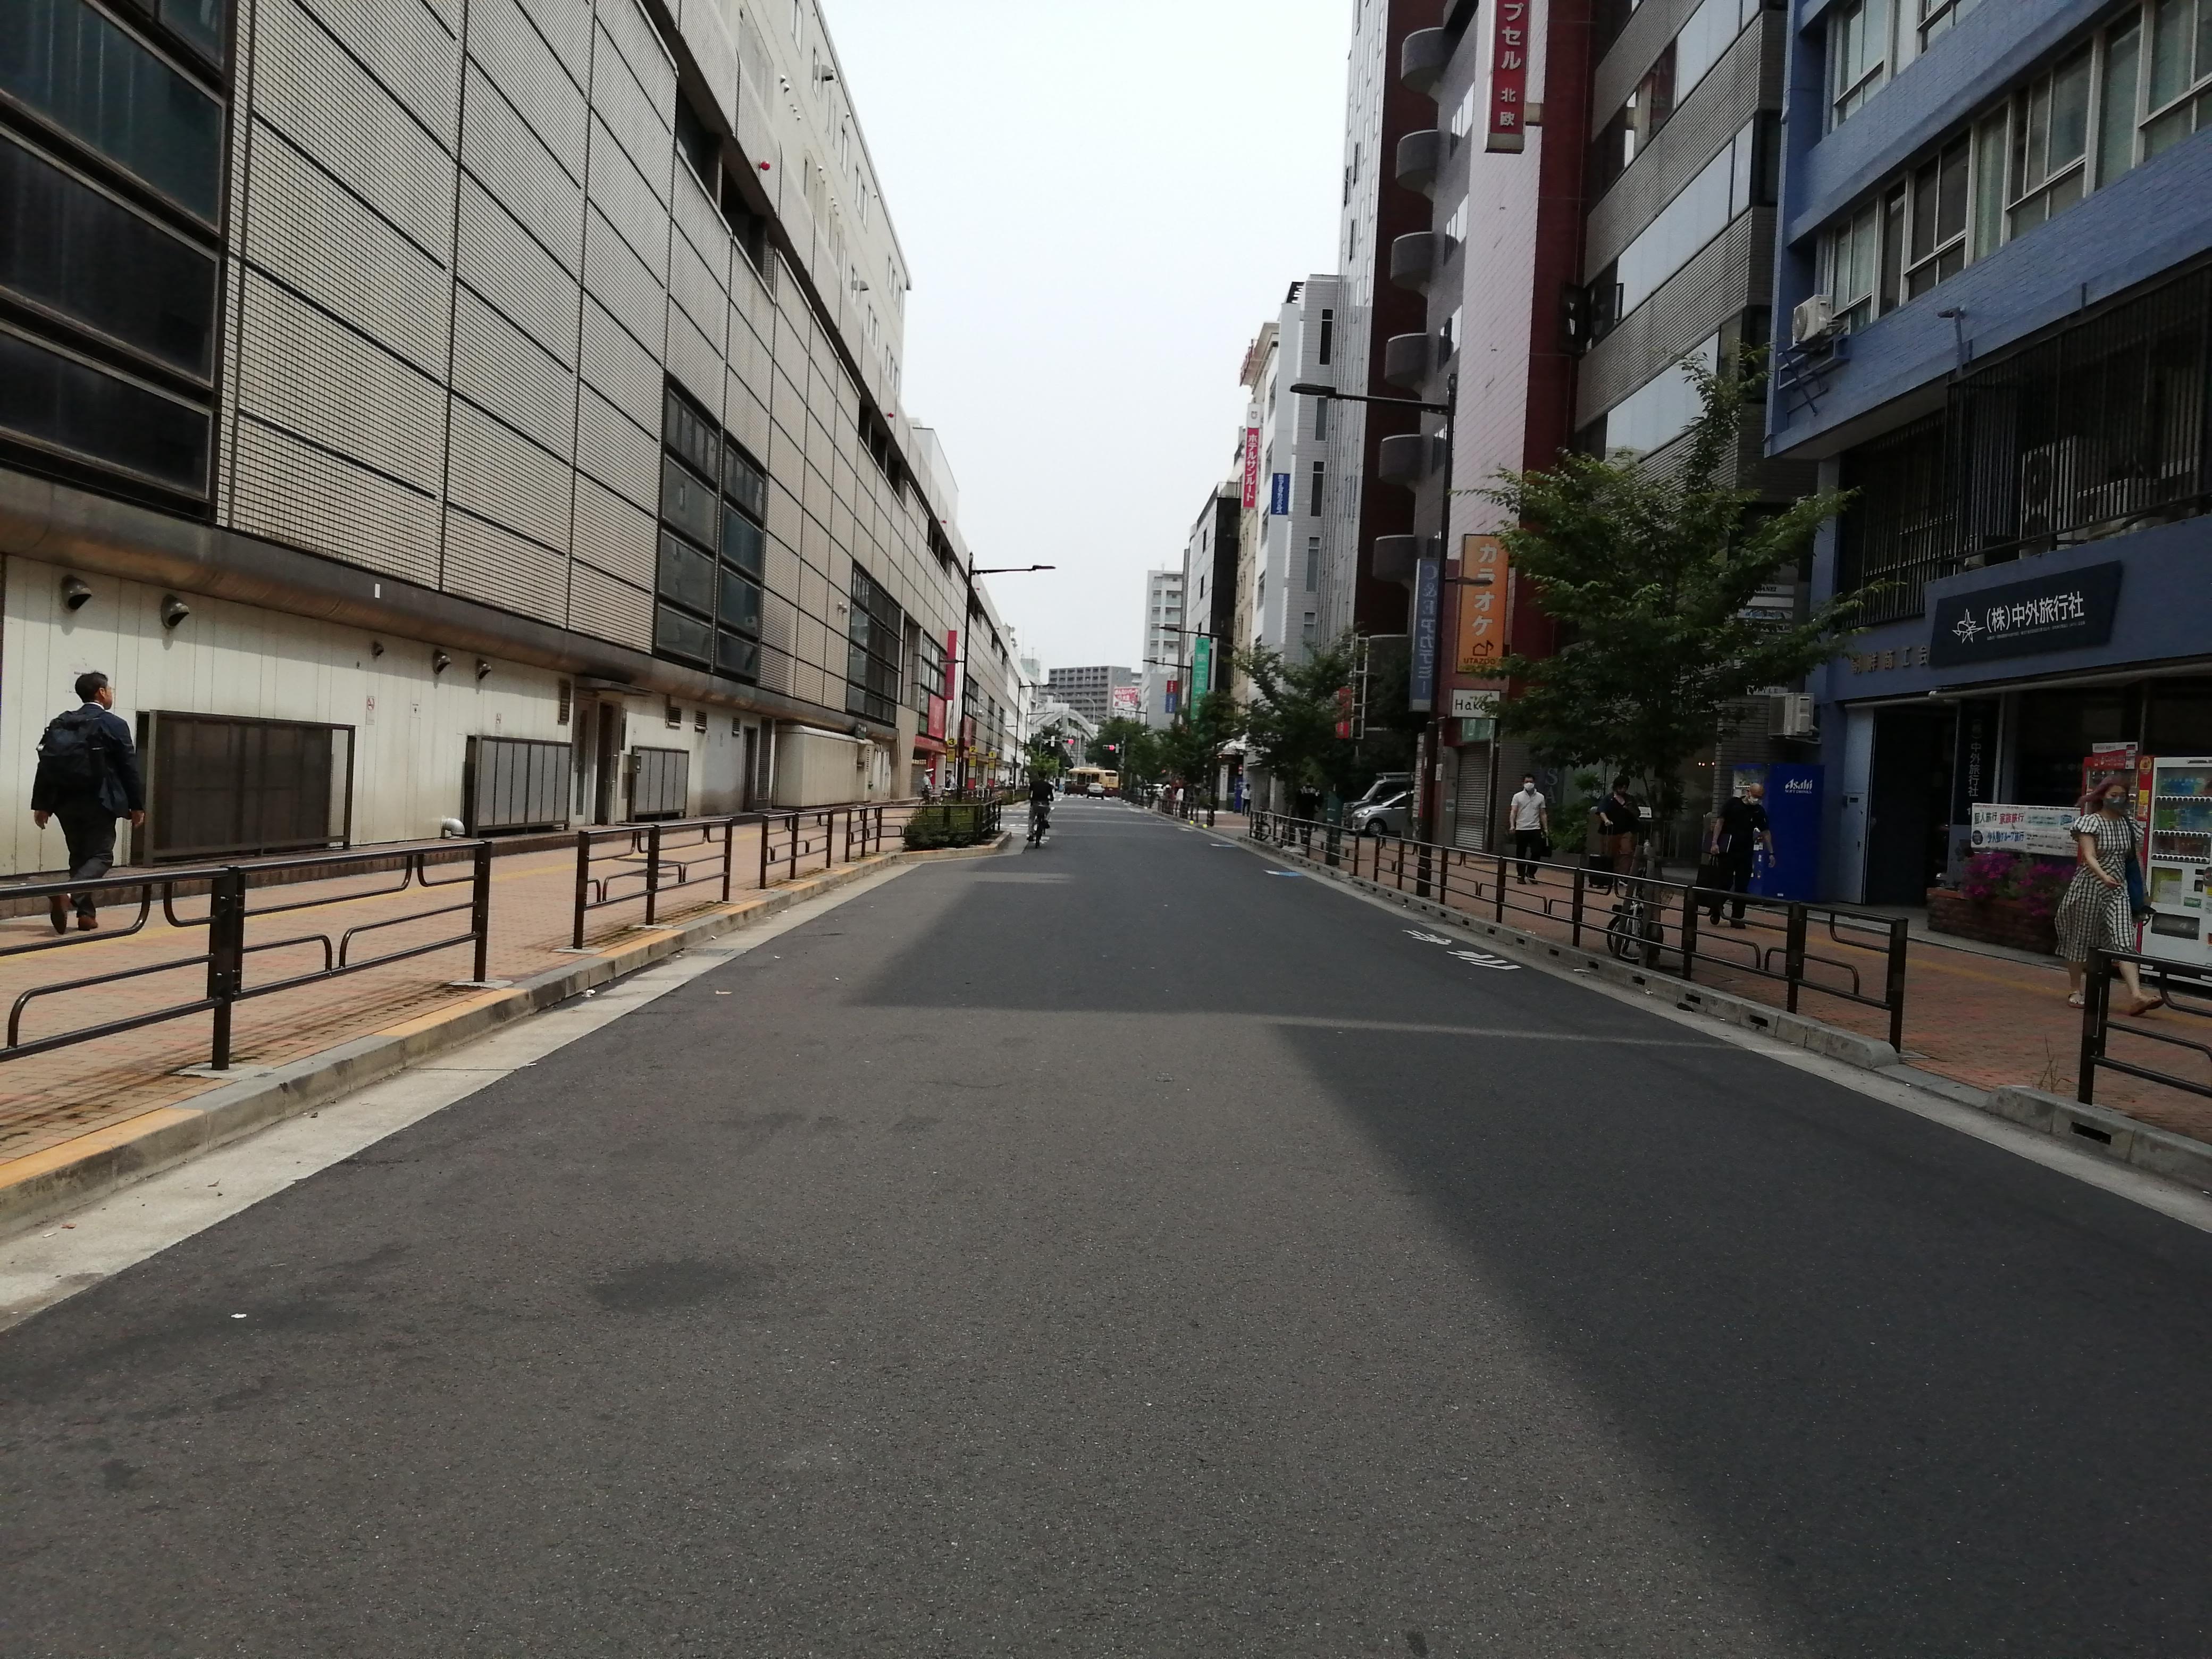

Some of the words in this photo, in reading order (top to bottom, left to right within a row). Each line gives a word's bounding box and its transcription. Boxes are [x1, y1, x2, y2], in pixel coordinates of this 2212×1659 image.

[1499, 87, 1516, 126] 北欧
[1245, 434, 1258, 501] ホテルサンルート
[1471, 542, 1498, 637] カラオケ
[1987, 591, 2085, 633] (株)中外旅行社
[1784, 778, 1813, 790] Asahi
[1999, 812, 2025, 825] 家族旅行
